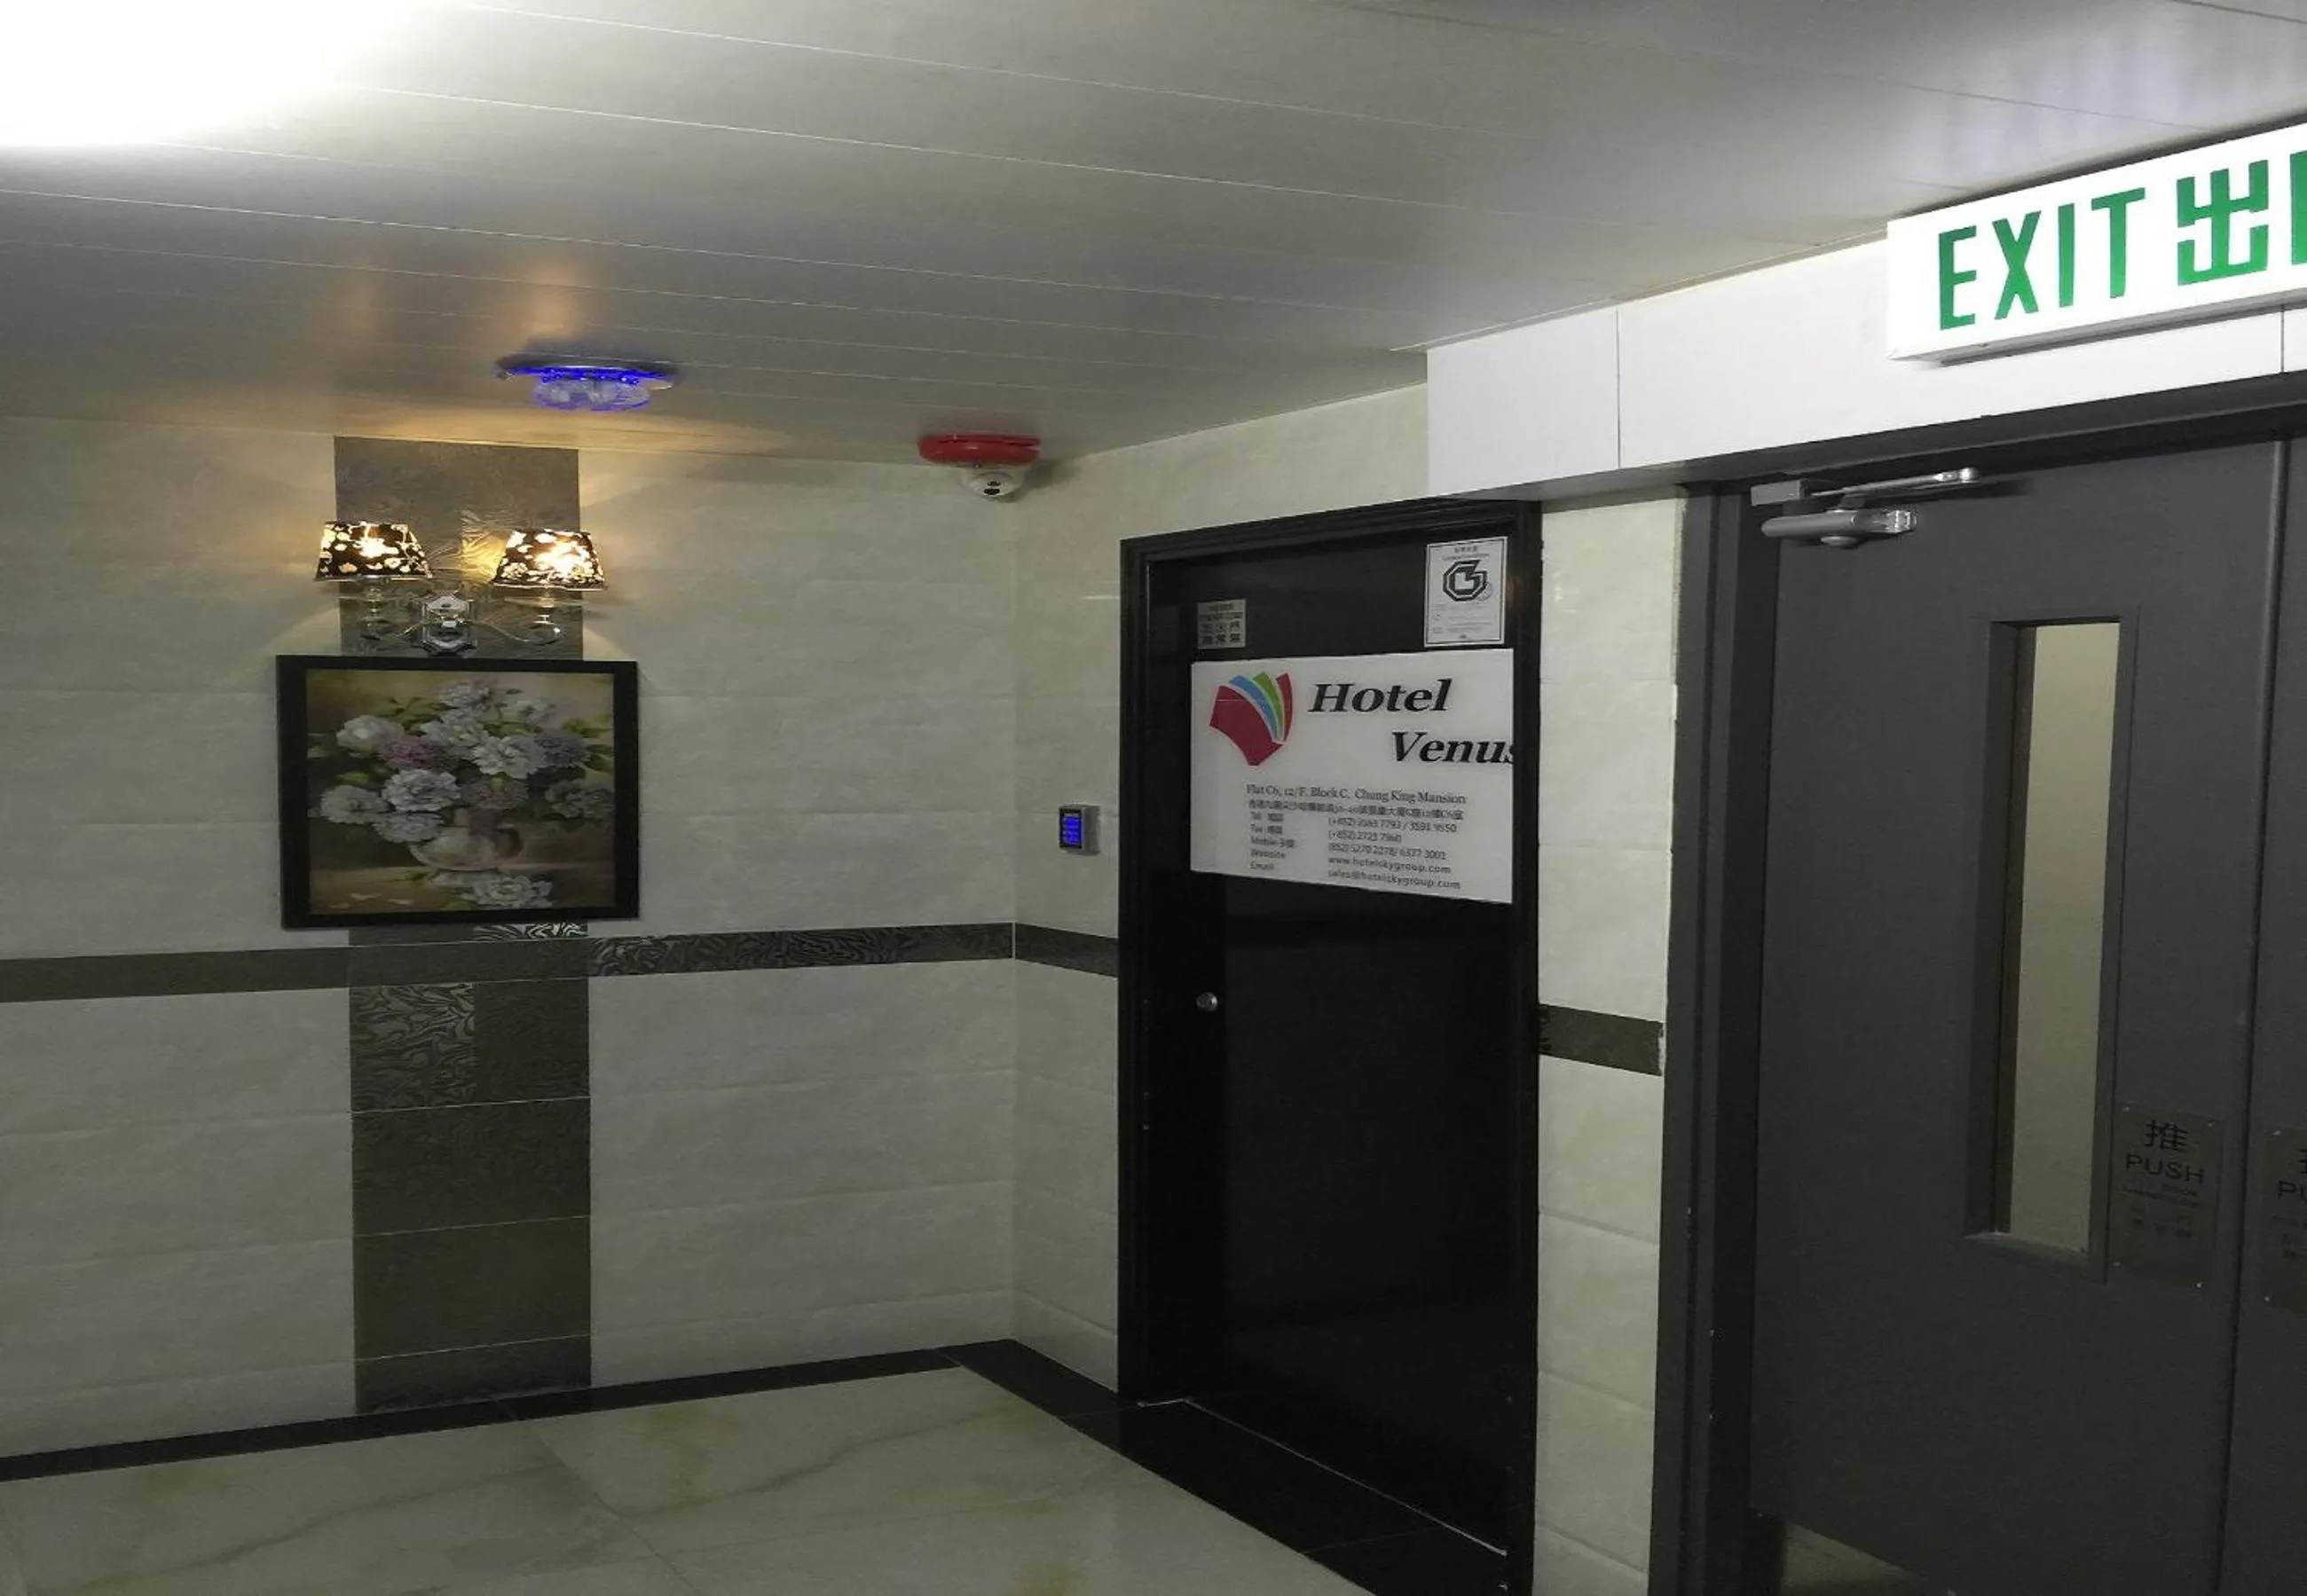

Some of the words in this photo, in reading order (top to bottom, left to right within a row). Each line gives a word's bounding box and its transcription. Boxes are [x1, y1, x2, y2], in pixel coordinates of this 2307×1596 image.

[2177, 150, 2307, 286] 出
[1939, 187, 2146, 330] EXIT
[1307, 679, 1453, 712] Hotel
[1354, 789, 1389, 802] Chung
[1390, 790, 1415, 804] King
[1417, 791, 1466, 804] Mansion
[2144, 1120, 2187, 1151] 推
[2126, 1154, 2204, 1184] PUSH
